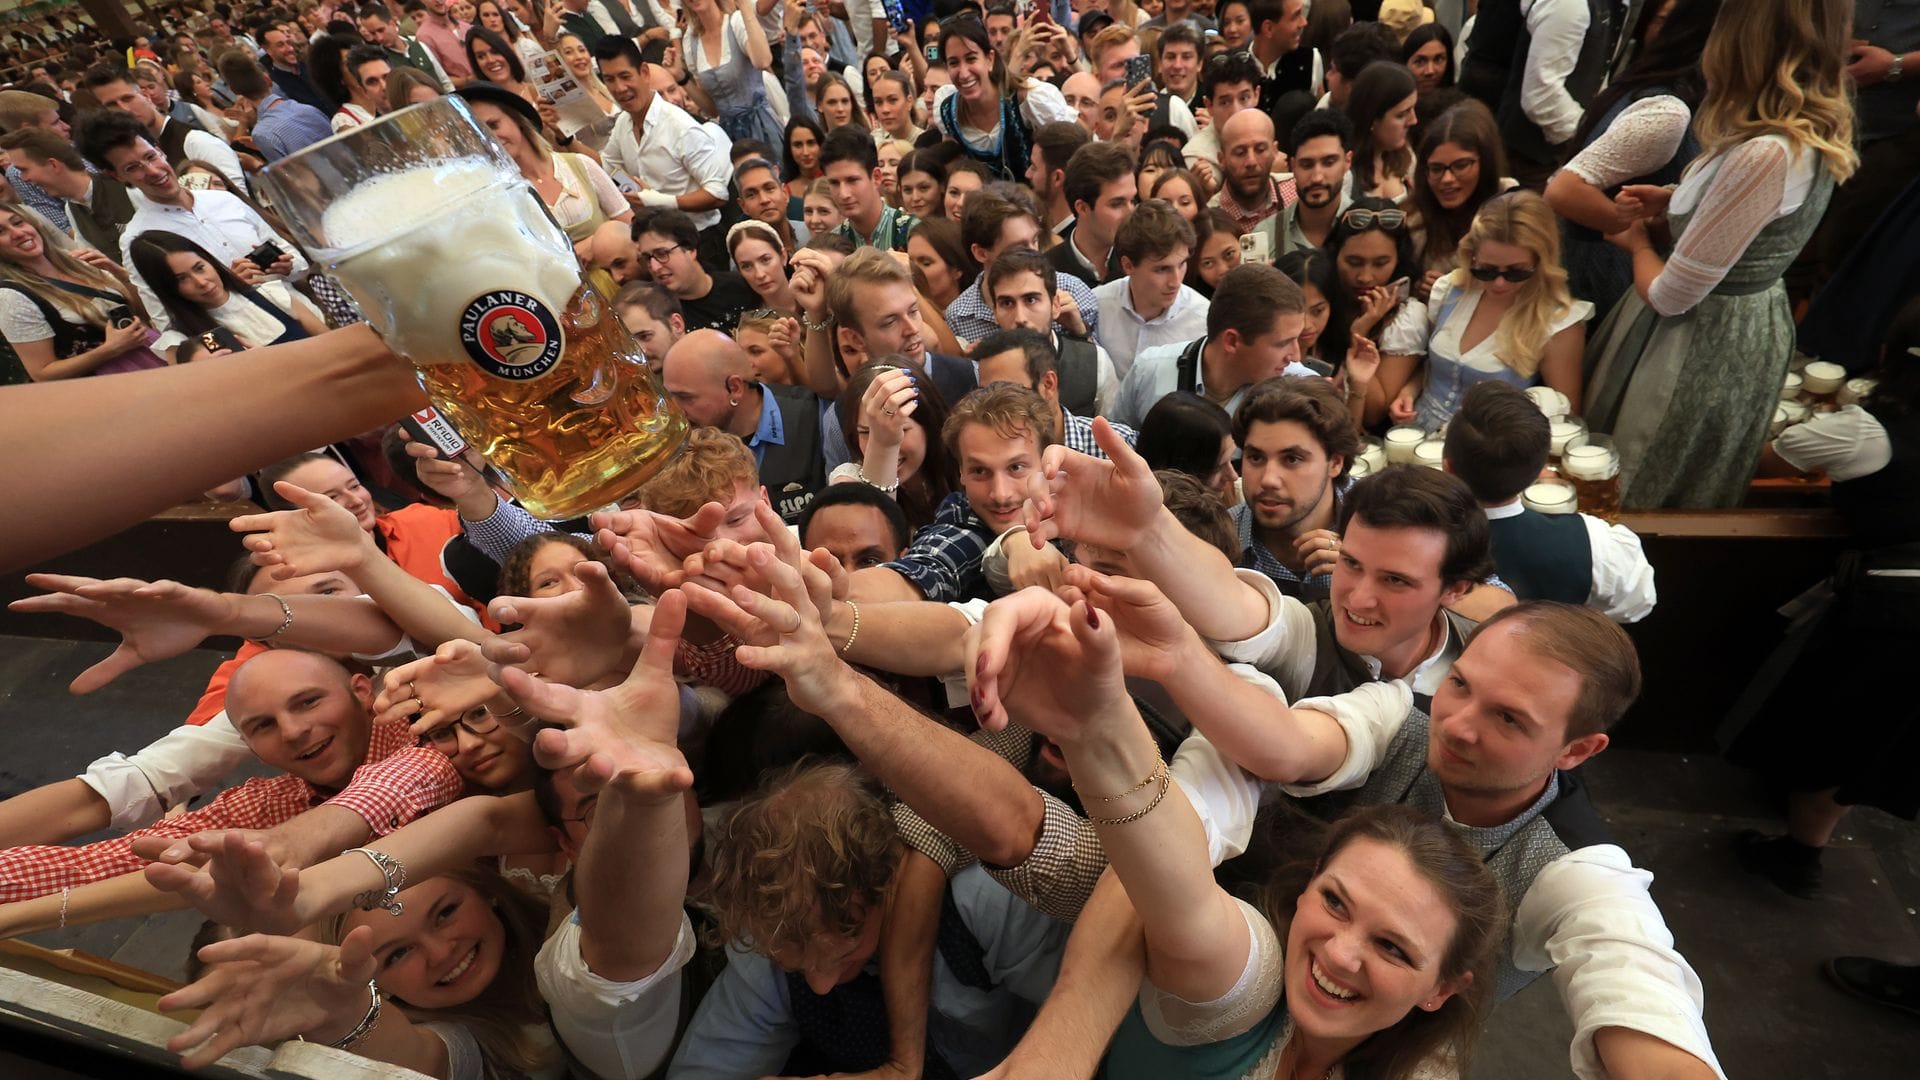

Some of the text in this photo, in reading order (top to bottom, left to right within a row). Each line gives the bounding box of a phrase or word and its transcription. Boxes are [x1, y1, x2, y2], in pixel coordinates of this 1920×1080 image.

[462, 292, 538, 342] PAULANER
[497, 339, 559, 377] MÜNCHEN
[431, 419, 461, 450] RADIO
